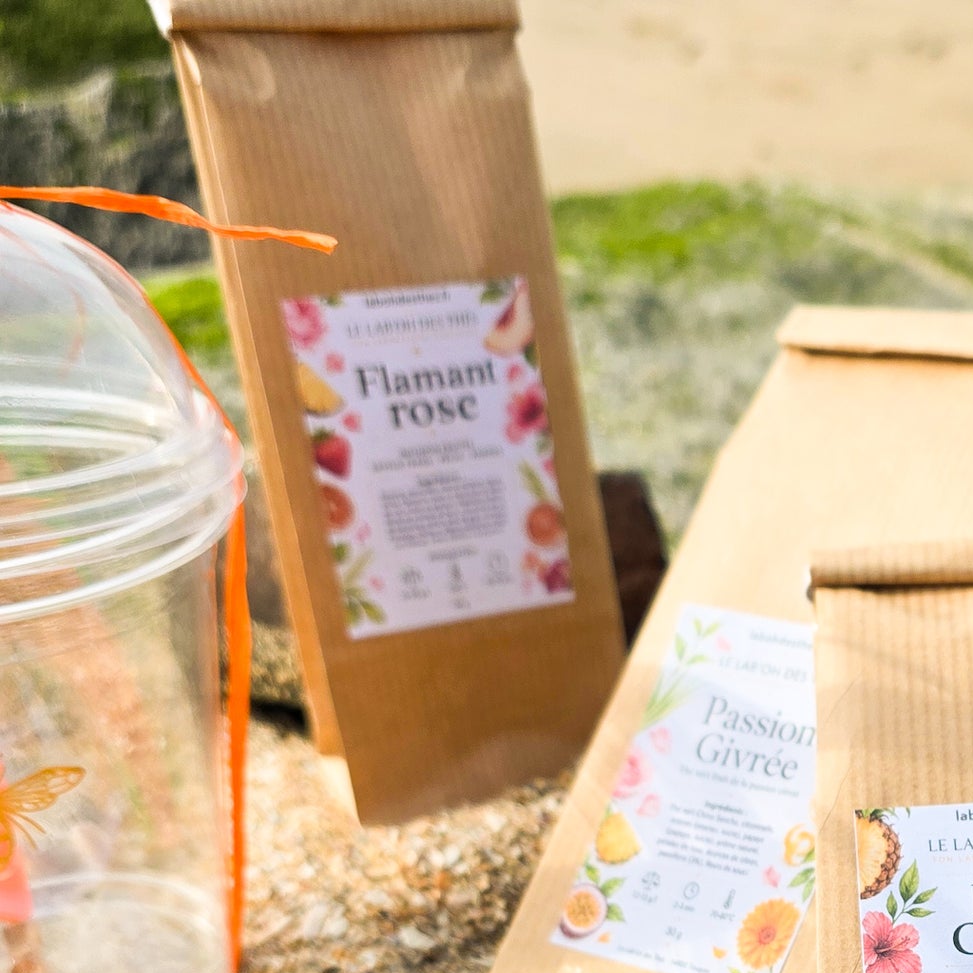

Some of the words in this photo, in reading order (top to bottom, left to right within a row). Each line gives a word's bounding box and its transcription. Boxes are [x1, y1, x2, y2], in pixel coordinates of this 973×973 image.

[355, 358, 497, 399] Flamant
[389, 394, 480, 430] rose
[703, 695, 817, 748] Passion
[695, 732, 799, 781] Givrée
[928, 839, 948, 852] LE
